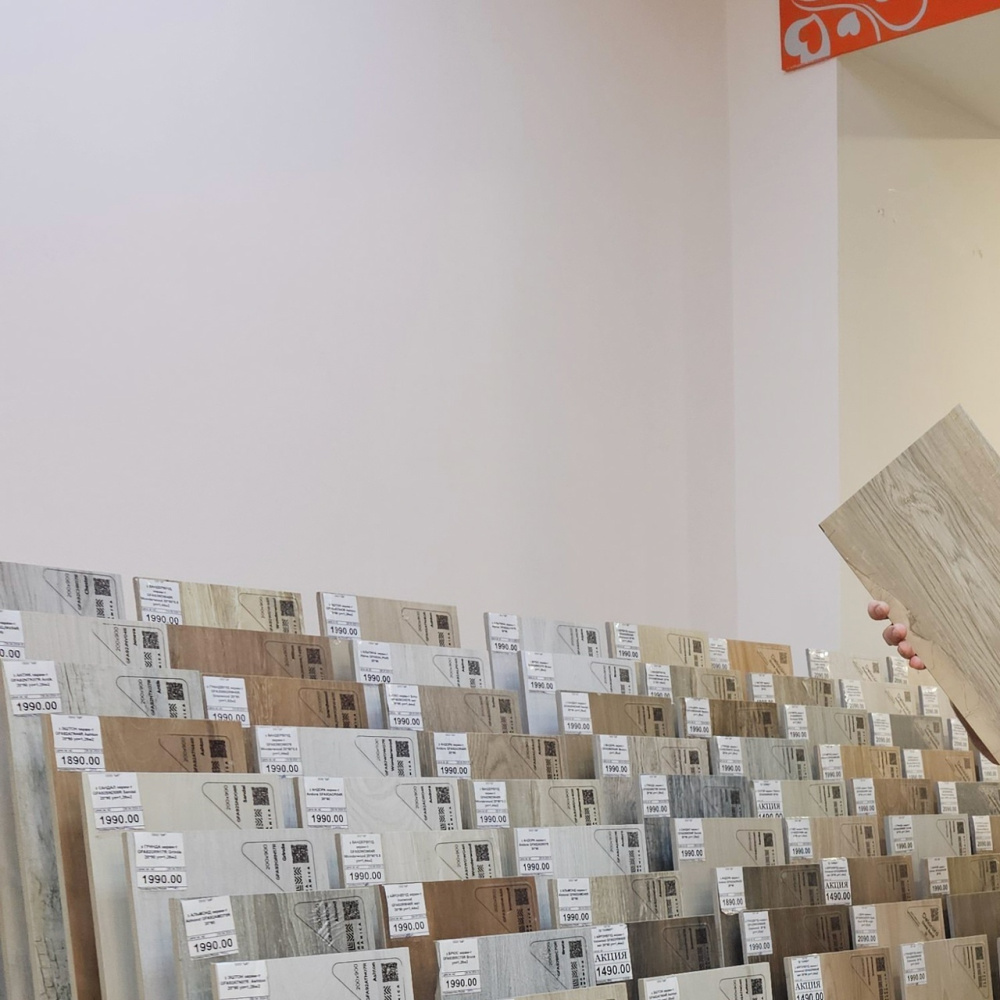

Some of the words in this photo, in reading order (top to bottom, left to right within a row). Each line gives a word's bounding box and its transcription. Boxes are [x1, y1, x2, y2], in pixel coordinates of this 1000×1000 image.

[147, 614, 178, 624] 1990.00
[331, 627, 357, 636] 1990.00
[495, 643, 517, 651] 1990.00
[363, 674, 390, 683] 1990.00
[17, 701, 57, 711] 1990.00
[213, 713, 246, 722] 1990.00
[61, 756, 100, 765] 1890.00
[100, 814, 139, 824] 1990.00
[312, 814, 343, 823] 1990.00
[142, 875, 182, 884] 1990.00
[350, 872, 382, 880] 1990.00
[826, 892, 850, 900] 1490.00
[563, 913, 589, 921] 1990.00
[394, 922, 424, 932] 1990.00
[194, 939, 232, 952] 1990.00
[595, 951, 628, 962] АКЦИЯ
[596, 963, 631, 977] 1490.00
[446, 978, 477, 988] 1990.00
[795, 981, 821, 991] АКЦИЯ
